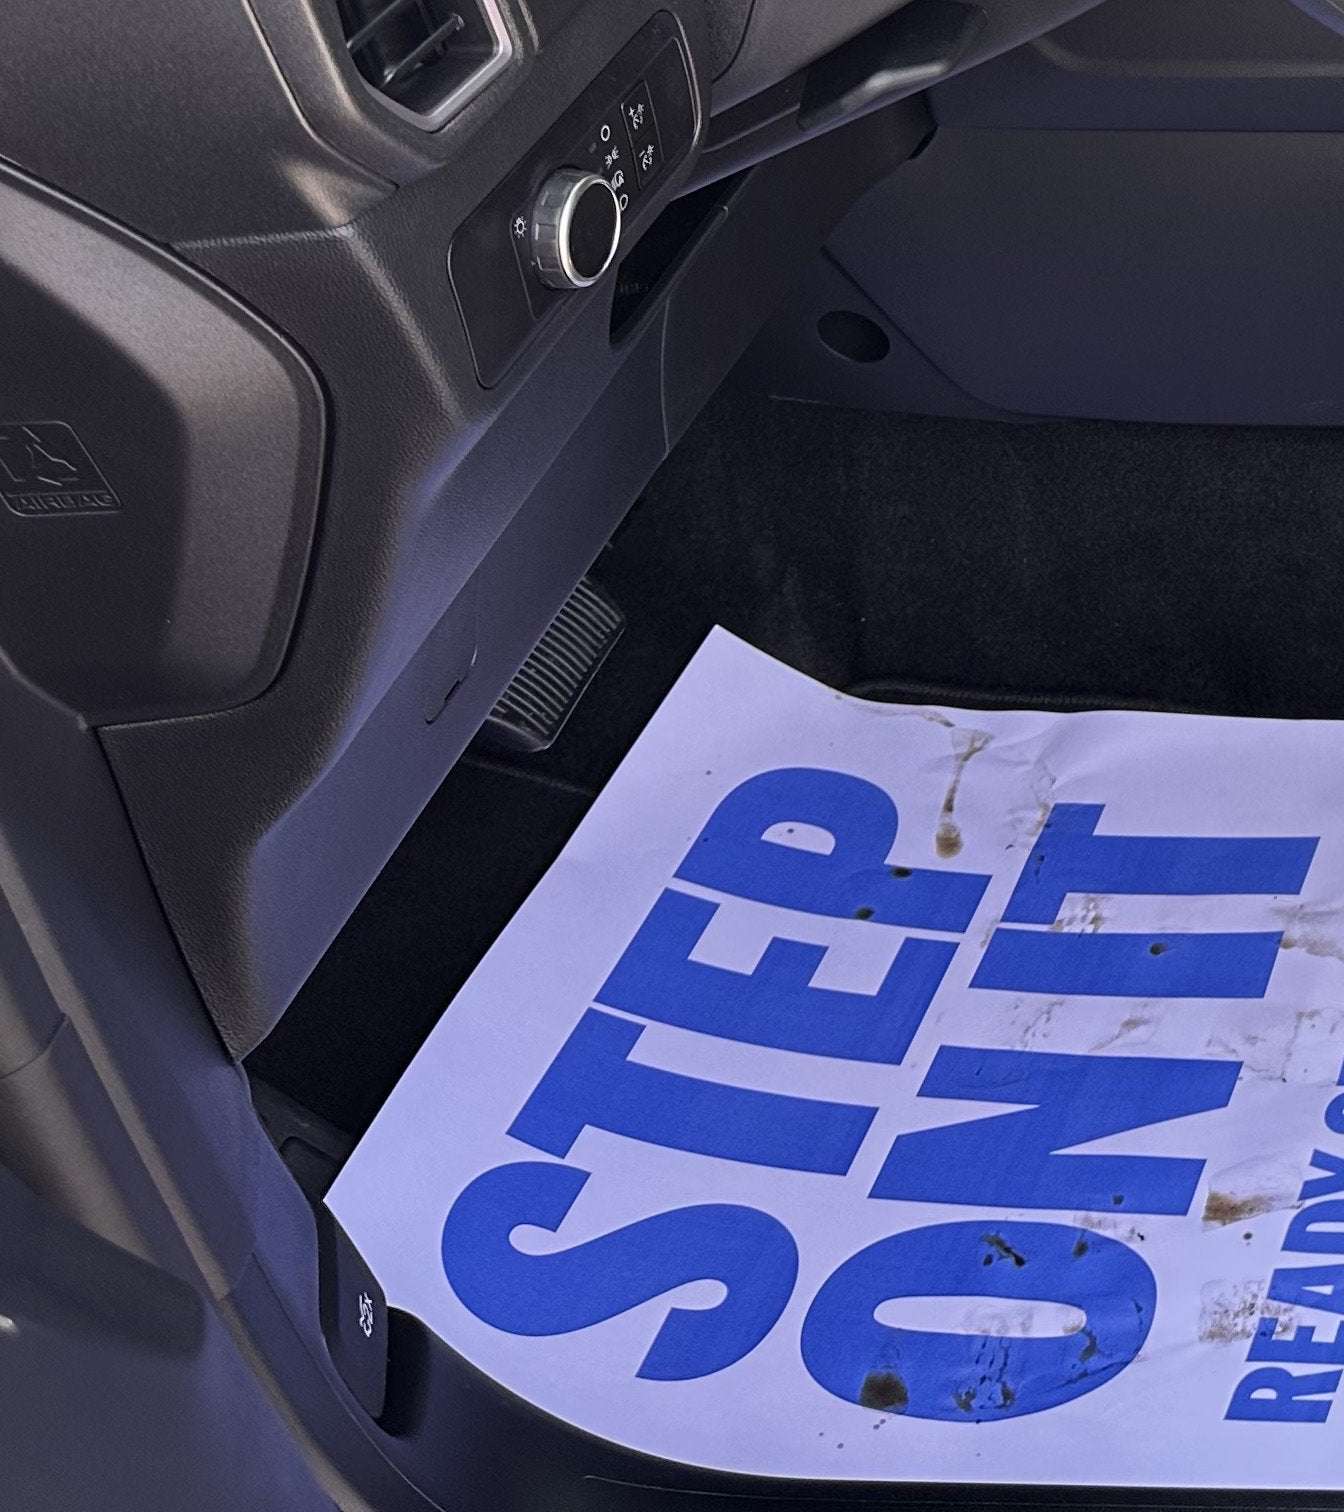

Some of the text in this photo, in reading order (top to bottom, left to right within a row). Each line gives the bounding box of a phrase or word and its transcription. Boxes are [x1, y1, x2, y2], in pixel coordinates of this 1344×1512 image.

[442, 768, 993, 1382] STEP
[801, 804, 1319, 1425] ON IT
